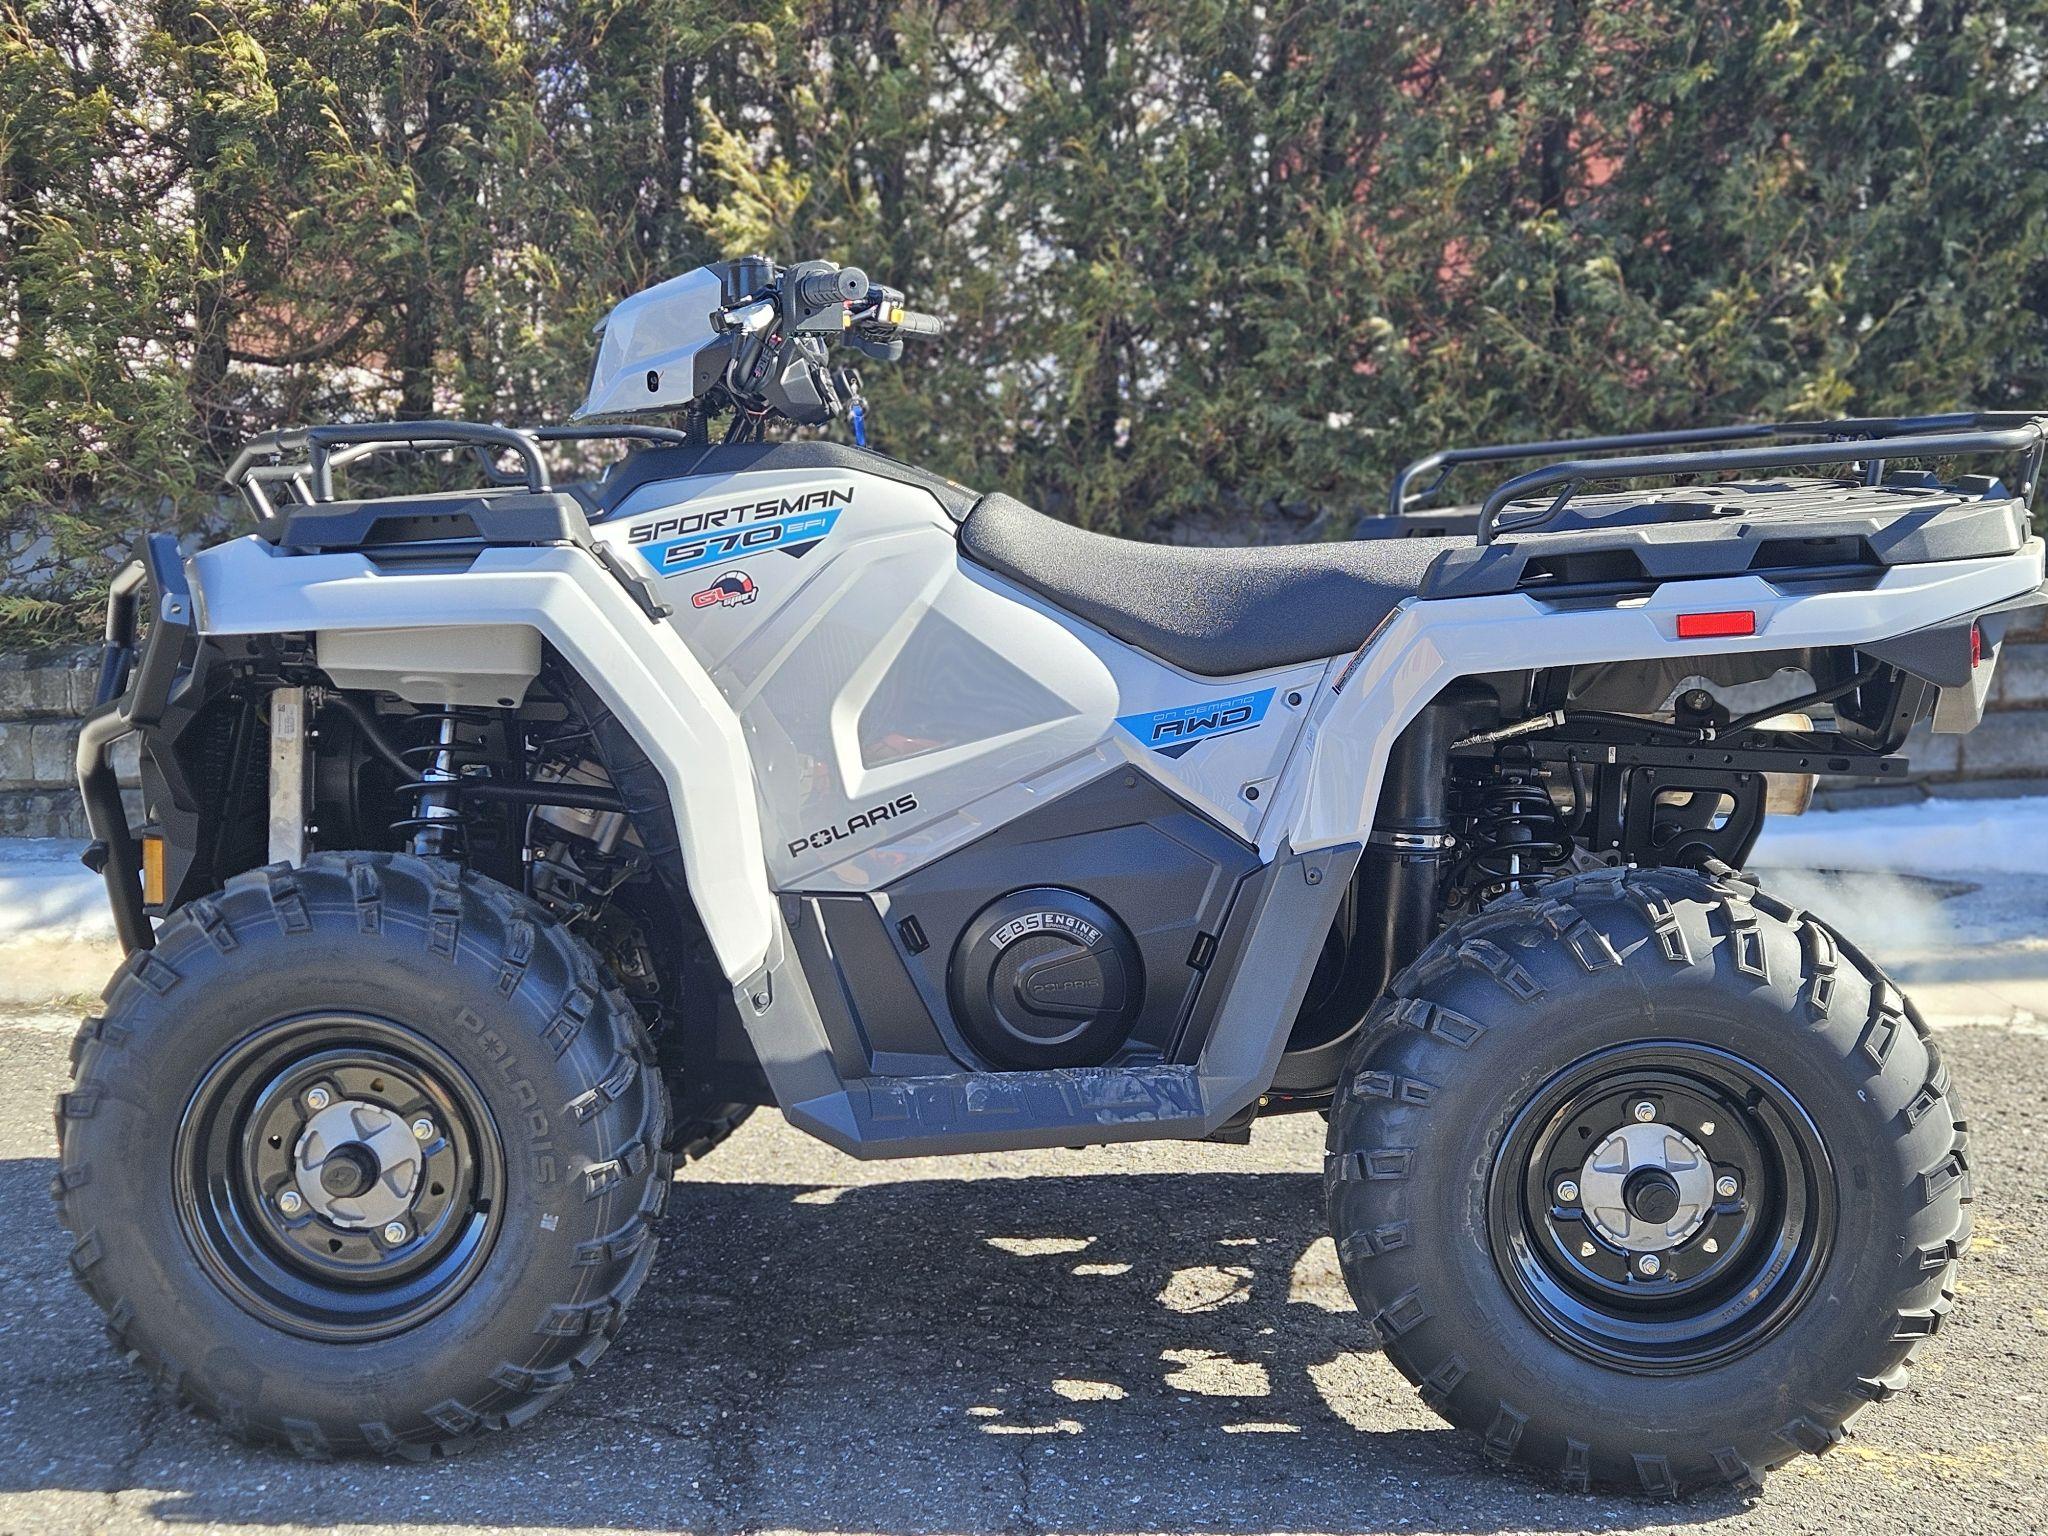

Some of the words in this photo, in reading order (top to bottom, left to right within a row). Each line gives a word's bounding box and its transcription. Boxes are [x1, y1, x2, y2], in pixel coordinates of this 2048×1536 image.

[628, 487, 854, 544] SPORTSMAN
[663, 525, 782, 567] 570
[786, 518, 826, 533] EPI
[1151, 704, 1254, 741] AWD
[1153, 711, 1177, 721] ON
[1184, 696, 1255, 716] DEMAND
[787, 792, 919, 858] POLARIS
[996, 915, 1040, 944] EBS
[1045, 914, 1099, 940] ENGINE
[1033, 978, 1099, 994] POLARIS
[456, 1006, 556, 1183] POLARIS
